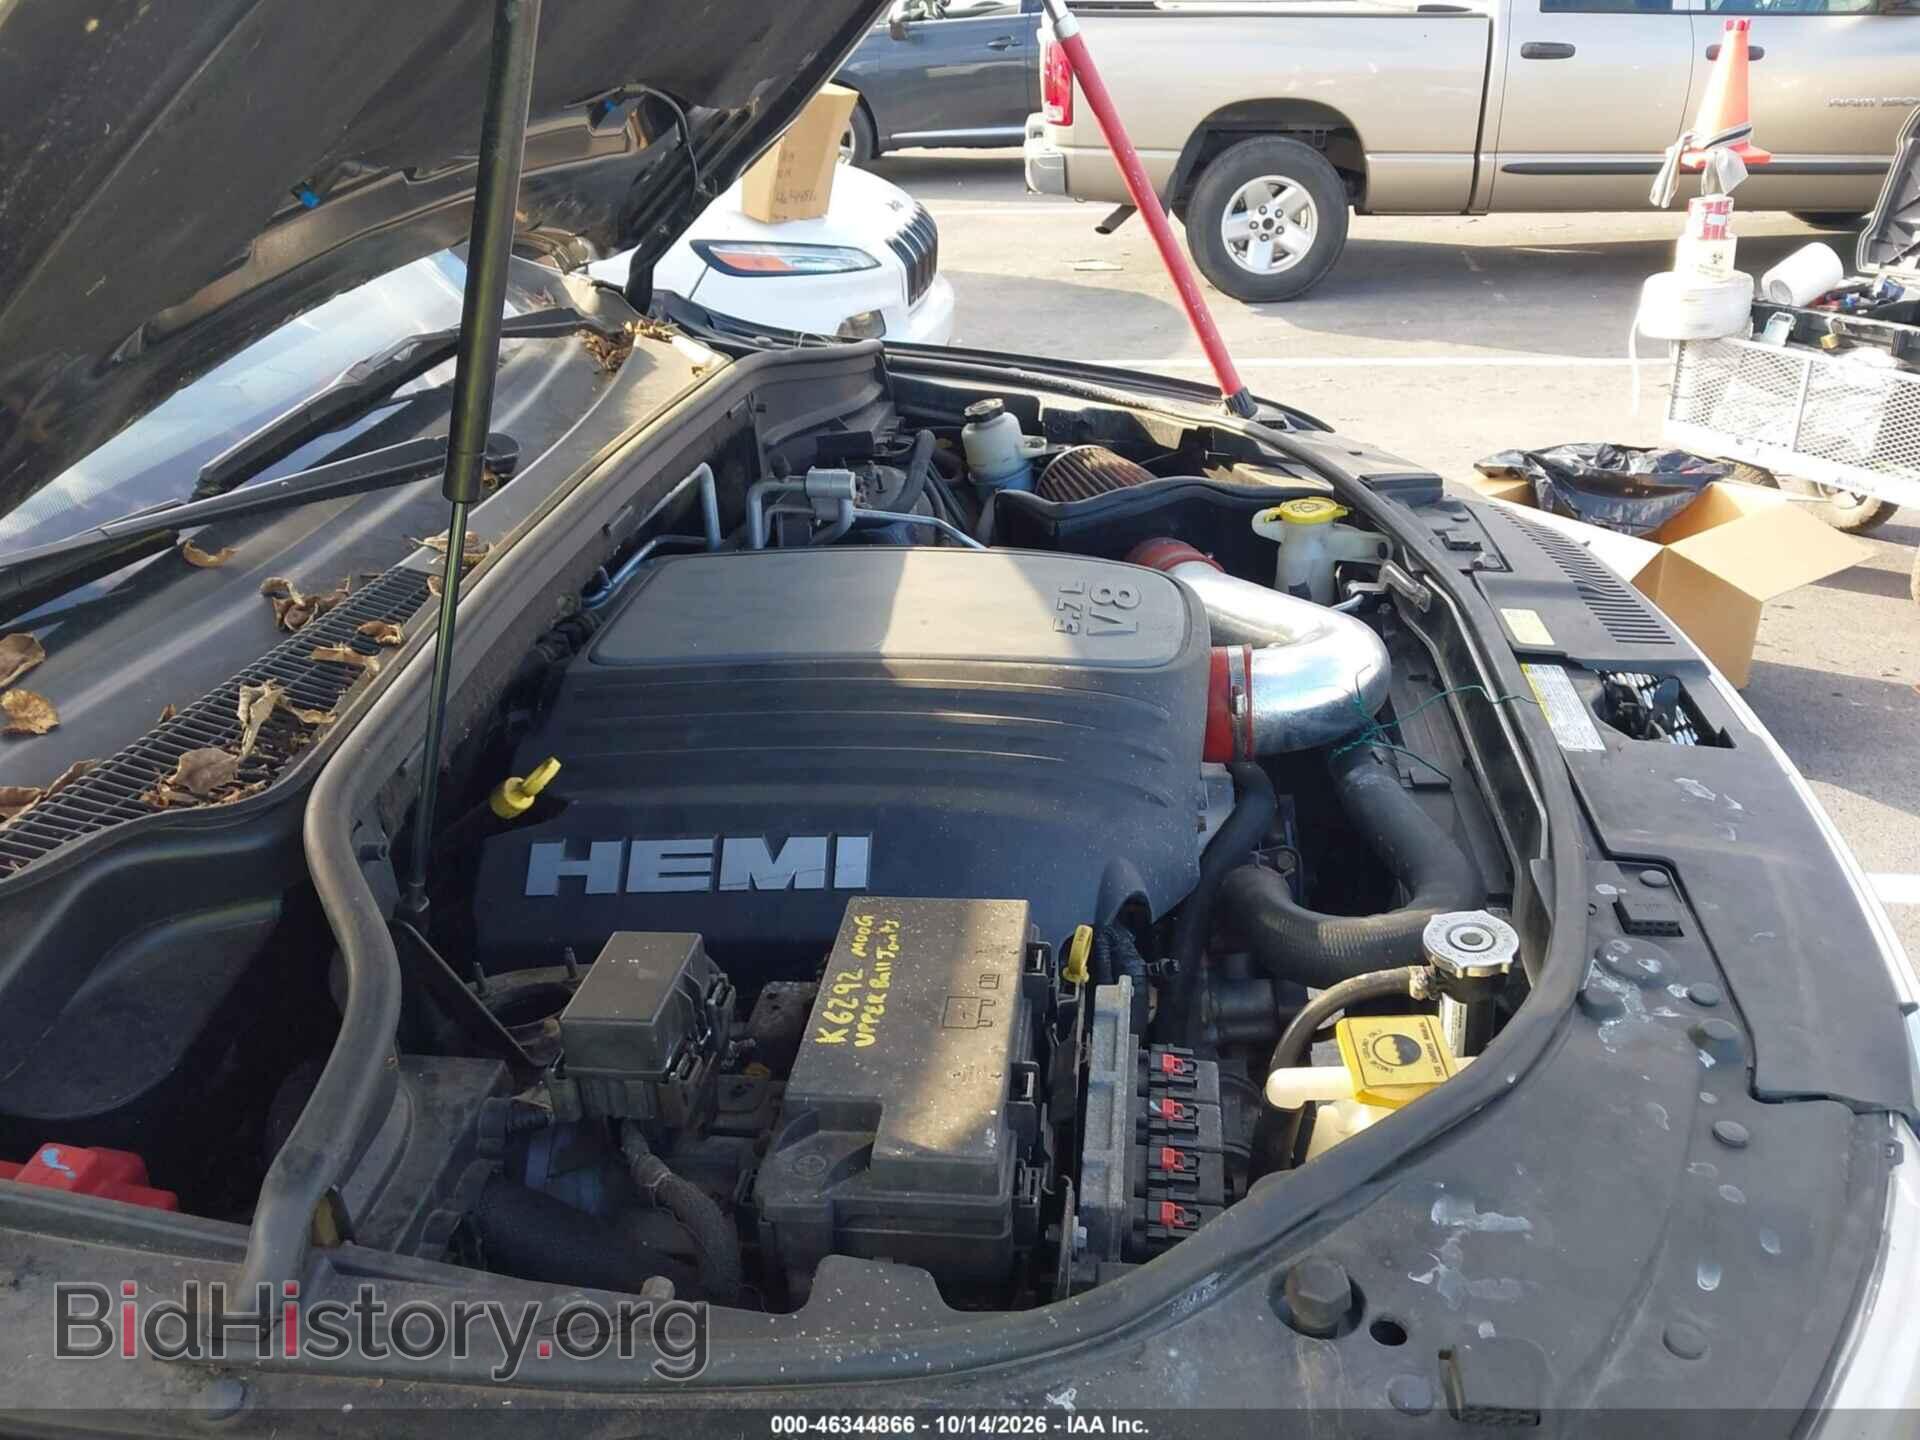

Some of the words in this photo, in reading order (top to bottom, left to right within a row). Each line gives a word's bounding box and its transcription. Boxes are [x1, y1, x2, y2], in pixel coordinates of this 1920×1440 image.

[1086, 581, 1142, 637] V8
[525, 832, 872, 896] HEMI
[850, 914, 875, 958] MOOG
[868, 961, 892, 989] Ball
[853, 992, 888, 1048] UPPER
